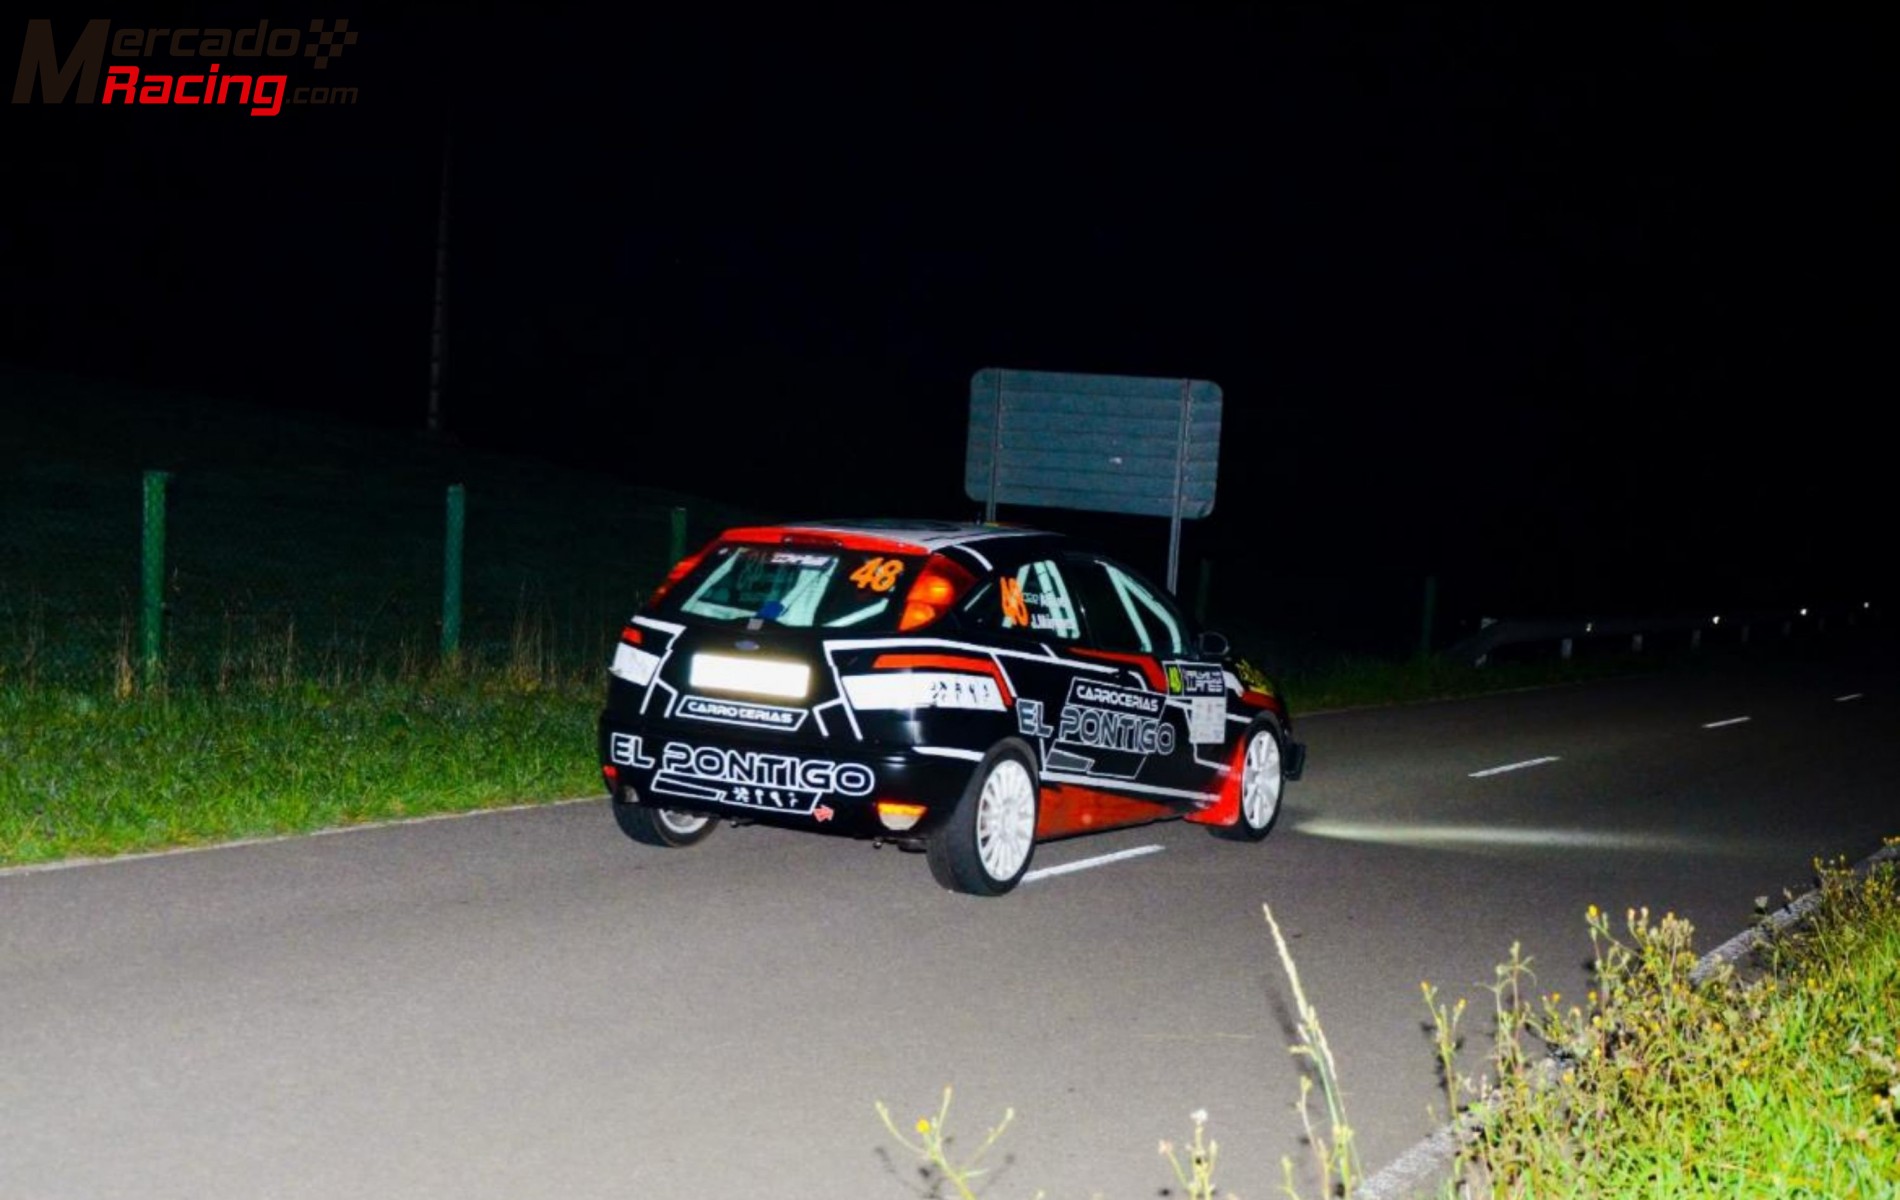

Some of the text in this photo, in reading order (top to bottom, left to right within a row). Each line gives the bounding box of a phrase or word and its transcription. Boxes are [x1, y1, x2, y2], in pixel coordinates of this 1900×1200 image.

[849, 556, 906, 593] 48
[1076, 684, 1160, 712] CARROCERIAS
[1016, 697, 1055, 738] EL
[1059, 707, 1176, 756] PONTIGO
[610, 732, 876, 797] EL PONTIGO
